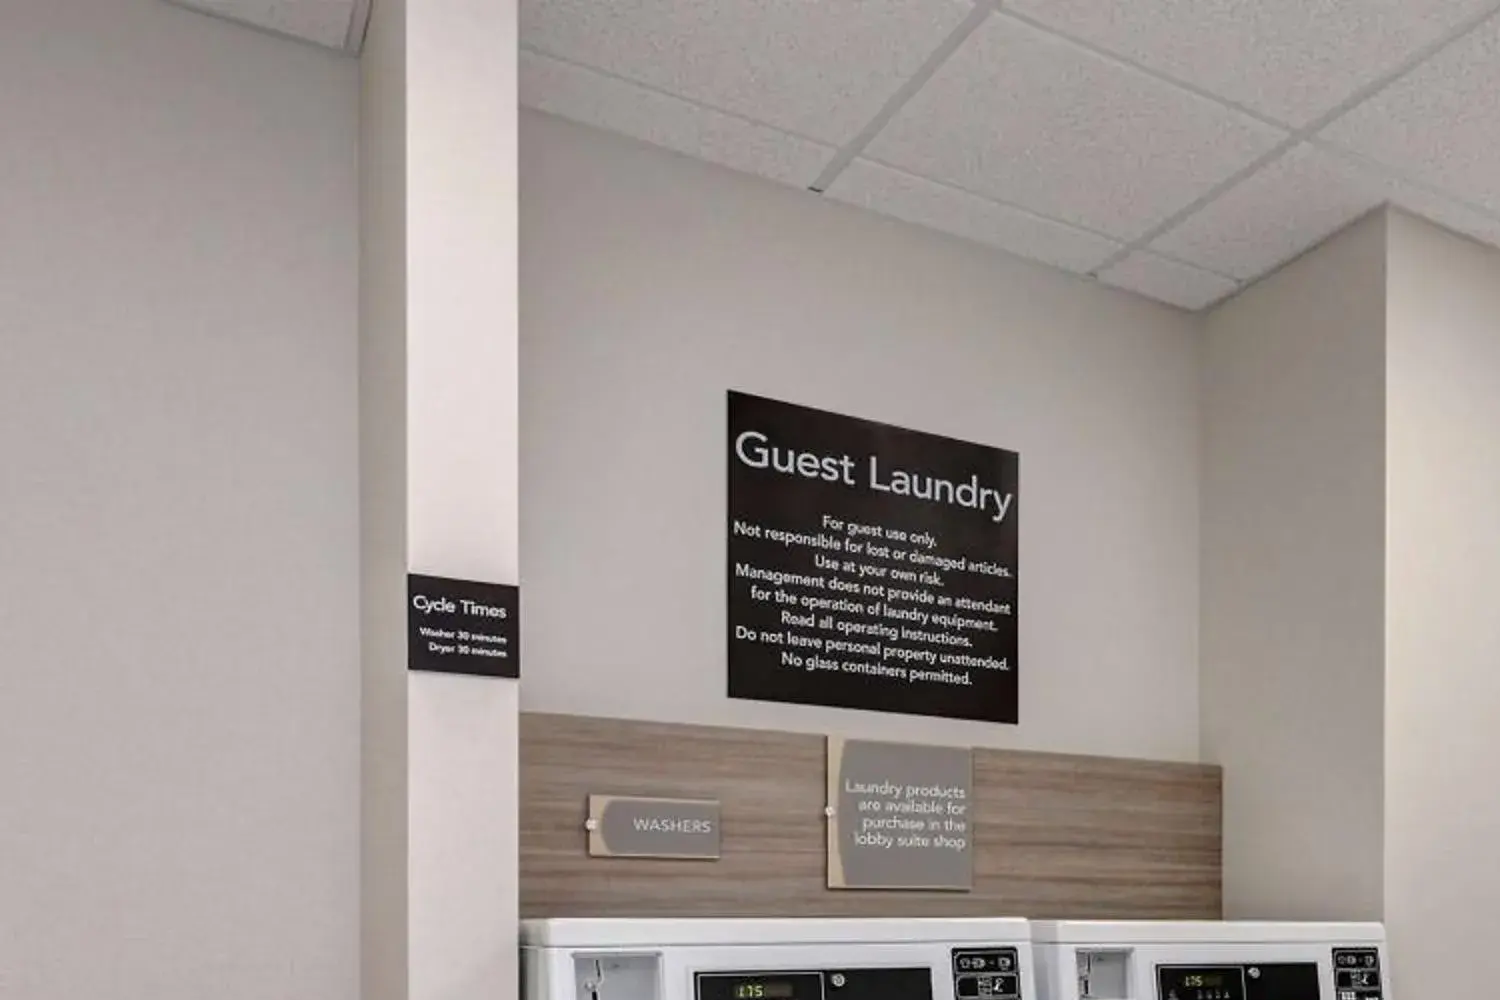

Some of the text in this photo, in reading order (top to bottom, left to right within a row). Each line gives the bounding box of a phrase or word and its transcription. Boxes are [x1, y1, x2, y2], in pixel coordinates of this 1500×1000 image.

[735, 431, 1012, 522] Guest Laundry
[823, 515, 937, 548] For guest use only.
[733, 520, 1013, 578] Not responsible for lost or damaged articles.
[815, 554, 944, 586] Use at your own risk.
[735, 563, 1011, 615] Management does not provide an attendant
[413, 595, 507, 619] Cycle Times
[750, 585, 998, 632] for the operation of laundry equipment.
[781, 610, 973, 647] Read all operating instructions.
[735, 625, 1010, 671] Do not leave personal property unattended.
[781, 652, 973, 685] No glass containers permitted.
[845, 778, 966, 799] Laundry products
[858, 800, 966, 815] are available for
[862, 816, 966, 832] purchase in the
[633, 817, 712, 833] WASHERS
[854, 831, 966, 852] lobby suite shop
